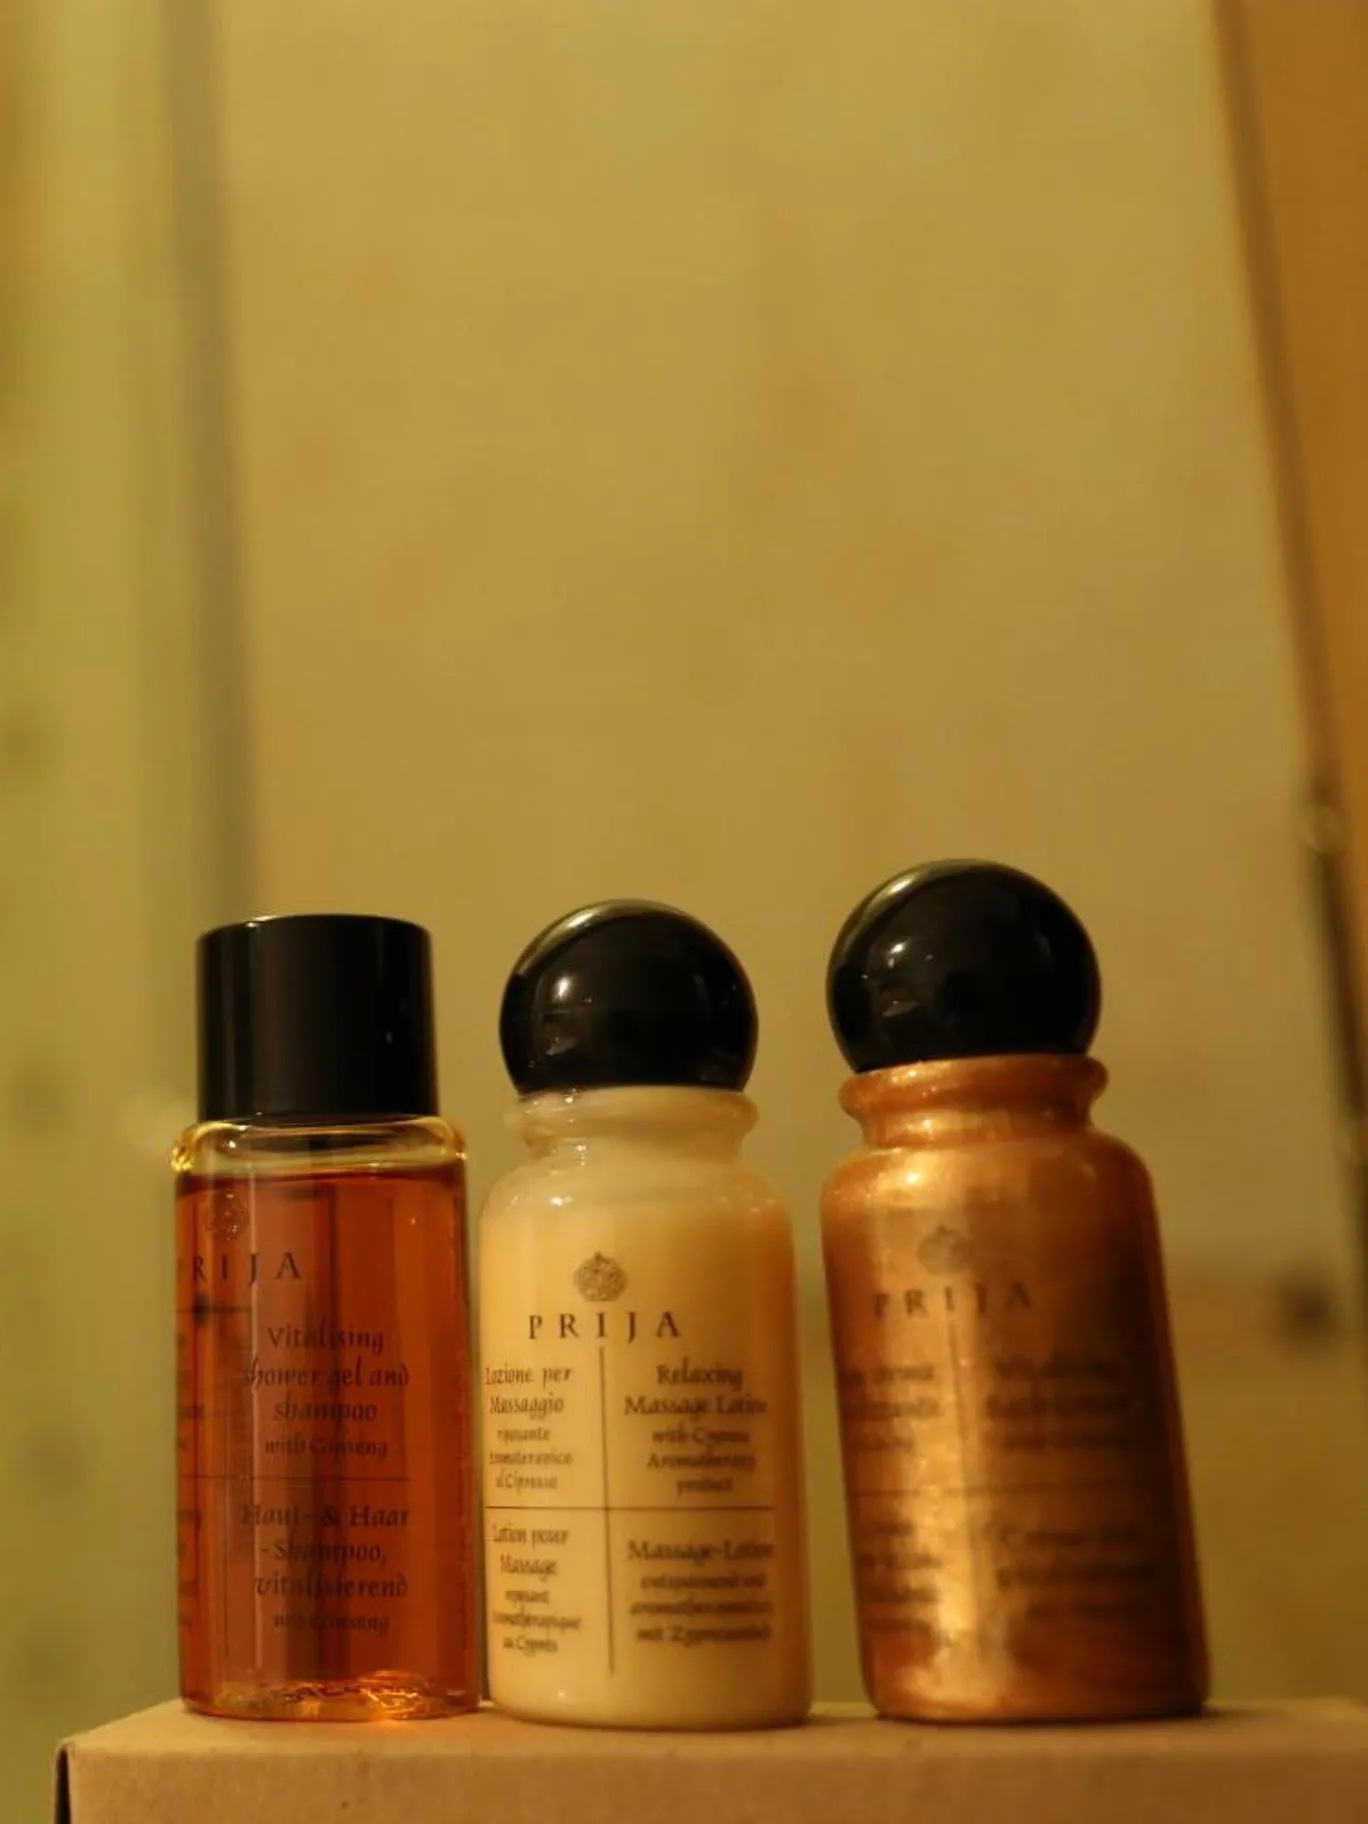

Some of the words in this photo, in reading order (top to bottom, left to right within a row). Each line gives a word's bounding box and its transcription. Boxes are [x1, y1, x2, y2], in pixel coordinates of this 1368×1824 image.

[528, 1311, 682, 1343] PRIJA
[542, 1366, 573, 1389] per
[655, 1356, 744, 1391] Relaxing
[489, 1391, 565, 1420] Massaggio
